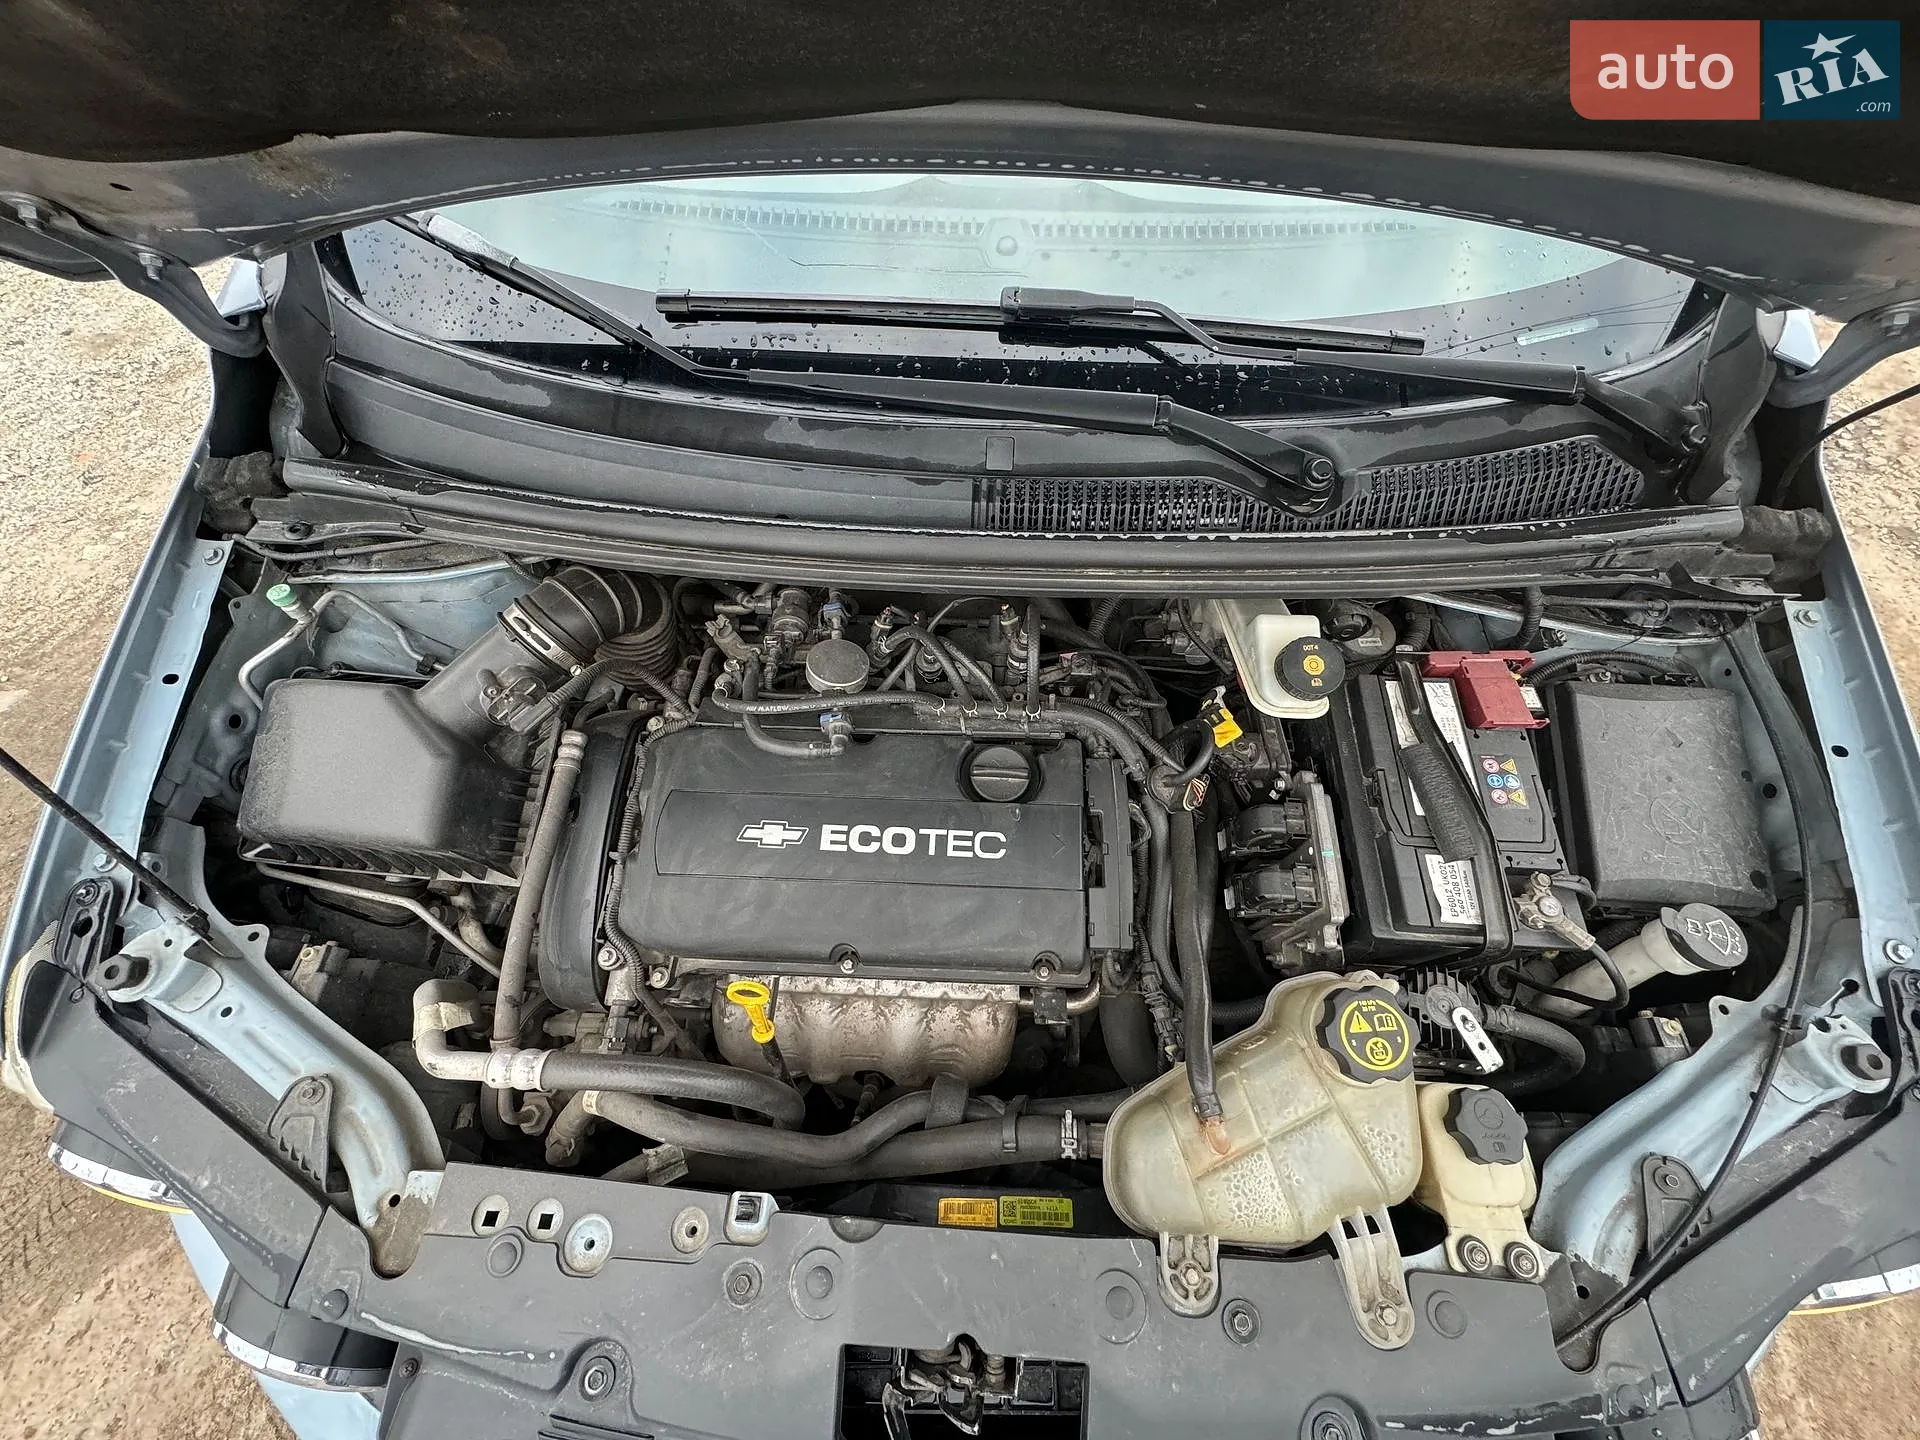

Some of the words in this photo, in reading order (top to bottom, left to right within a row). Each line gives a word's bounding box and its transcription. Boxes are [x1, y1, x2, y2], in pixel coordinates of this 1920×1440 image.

[820, 824, 1007, 860] ECOTEC
[1447, 864, 1458, 880] 054
[1452, 881, 1462, 898] 408
[1444, 888, 1459, 917] EP60L2
[1457, 898, 1467, 914] 560
